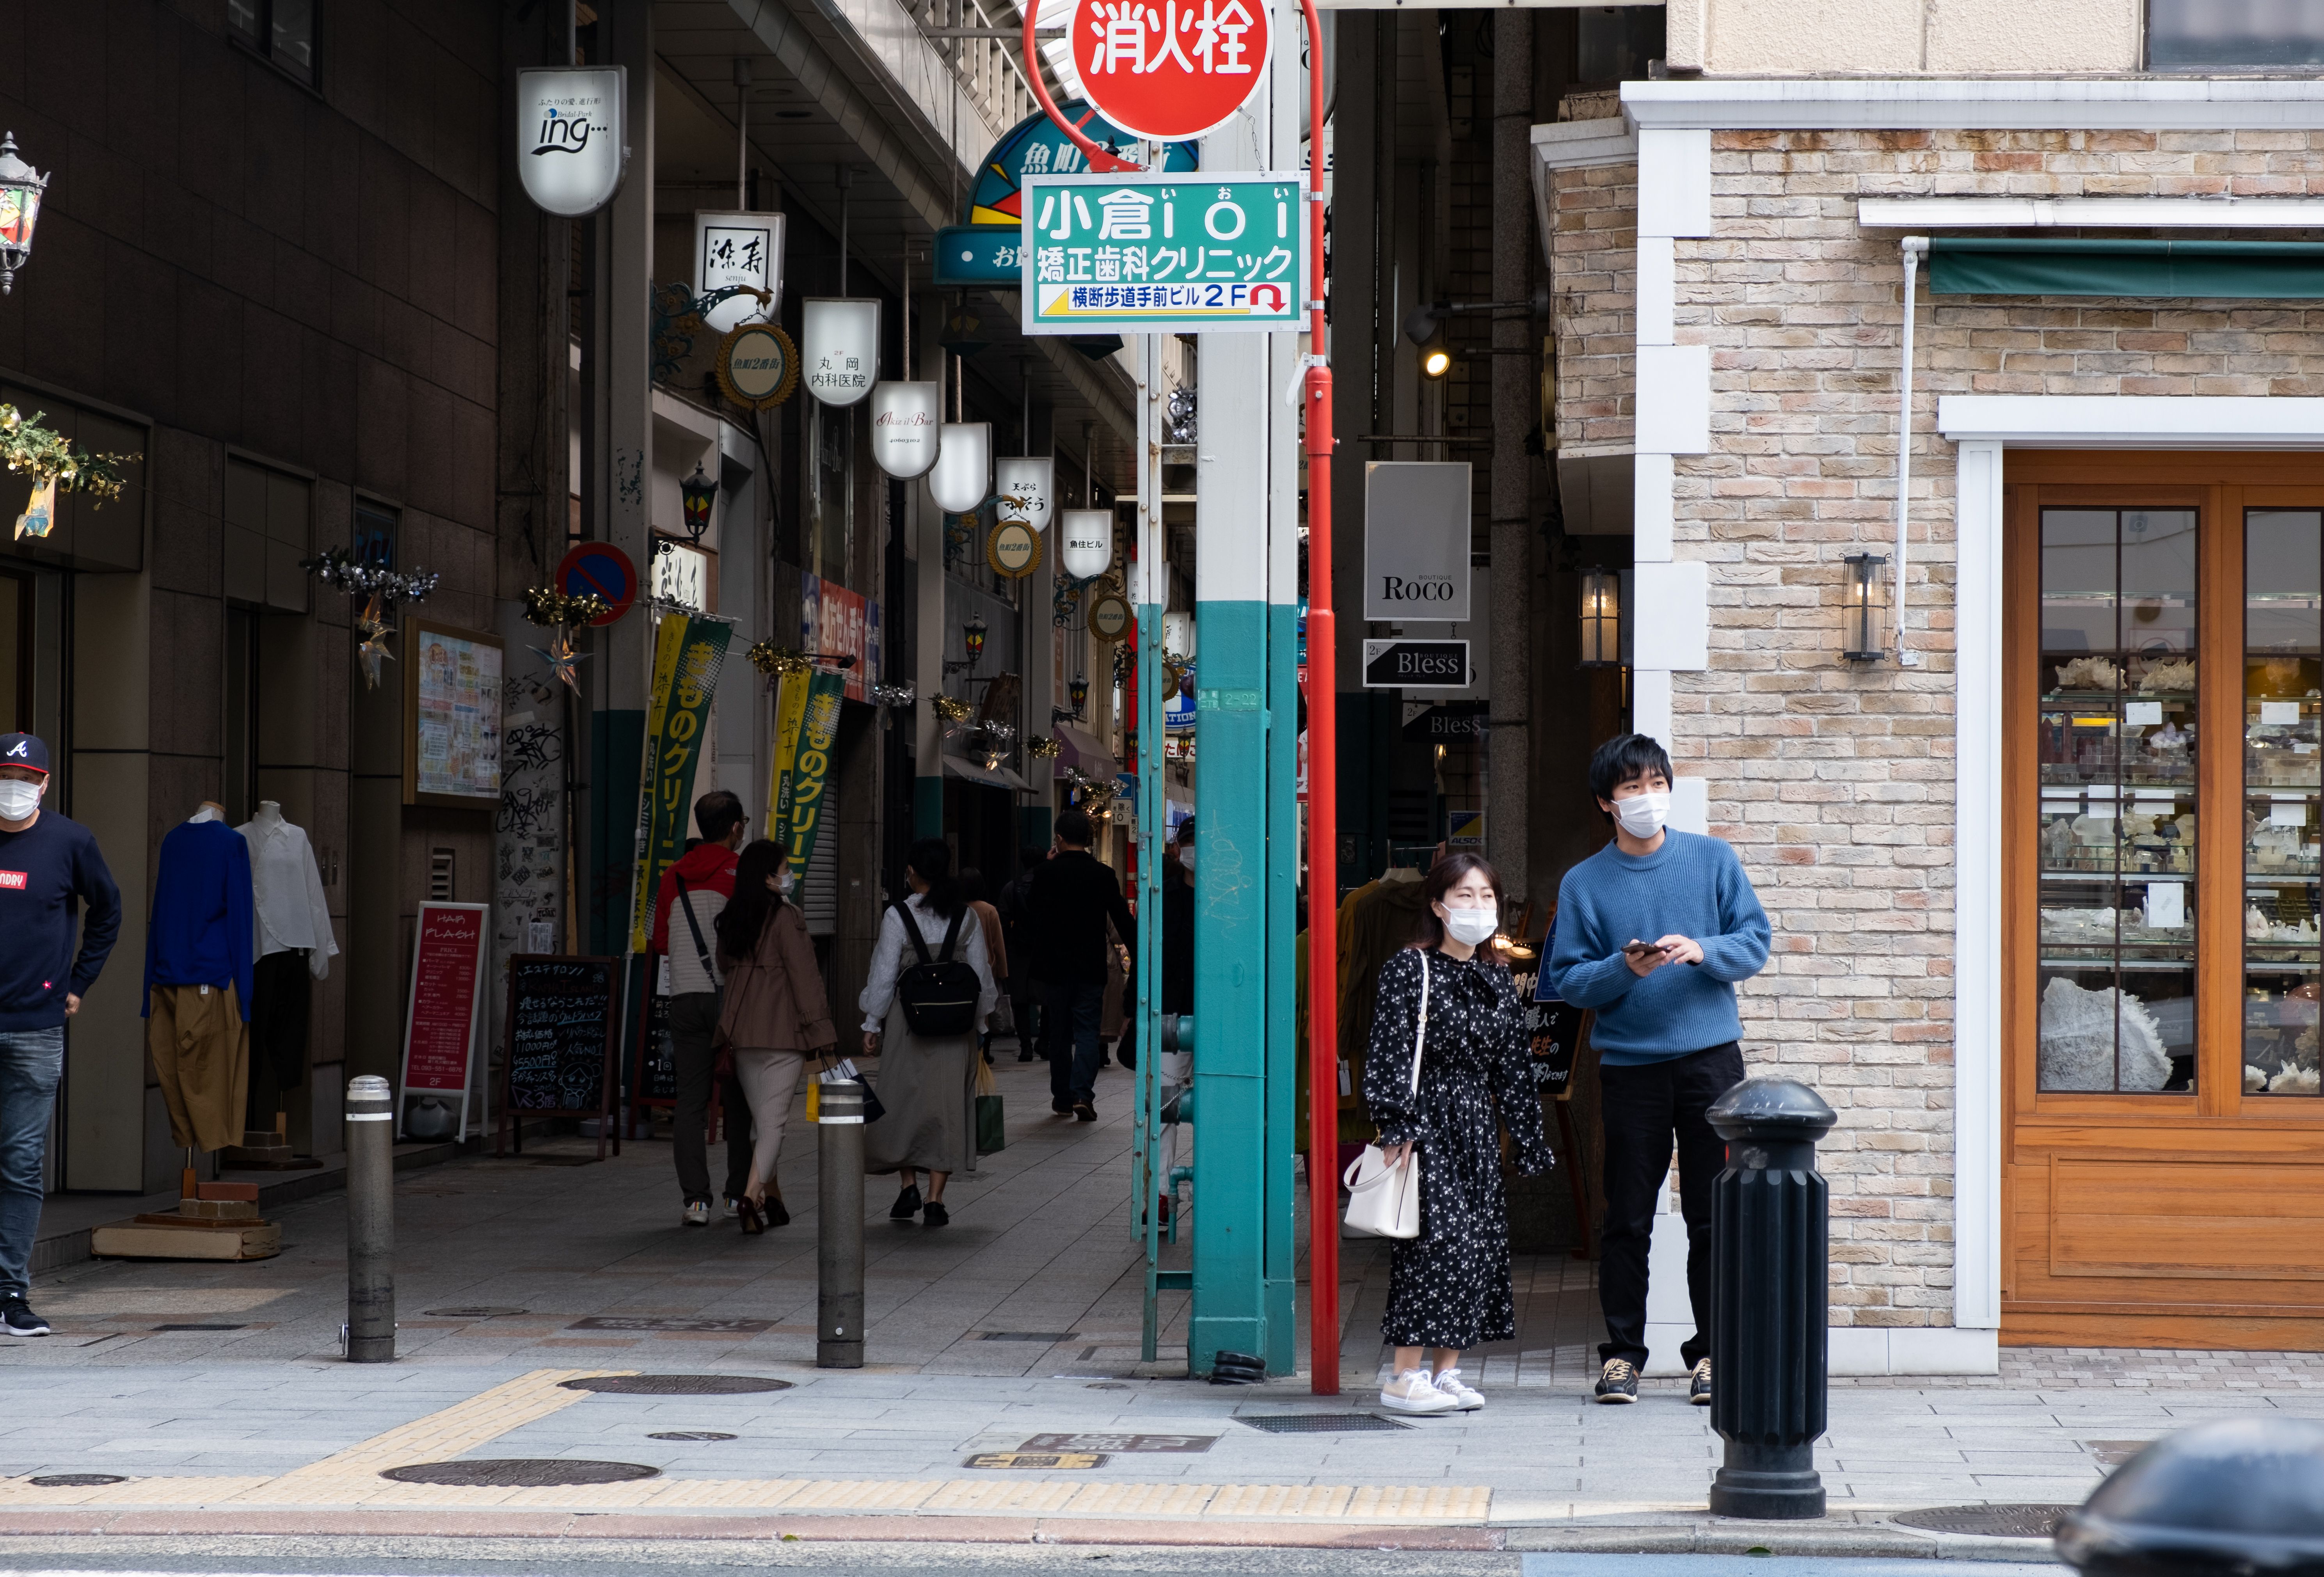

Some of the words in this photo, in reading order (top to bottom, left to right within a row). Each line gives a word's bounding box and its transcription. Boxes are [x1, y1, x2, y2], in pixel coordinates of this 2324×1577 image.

[1090, 0, 1254, 74] 消火栓
[1038, 245, 1292, 282] 矯正歯科クリニック
[725, 274, 746, 283] senju
[1073, 287, 1199, 307] 横断歩道手前ビル
[732, 357, 781, 370] 魚町2番街
[812, 373, 865, 387] 内科医院
[1012, 483, 1036, 491] 天ぷら
[999, 543, 1031, 551] 魚町2番街
[1070, 540, 1103, 549] 魚住ビル
[1369, 645, 1381, 655] 2F
[1397, 652, 1459, 673] Bless
[1225, 694, 1256, 705] 2-22
[1407, 708, 1417, 716] 2F
[1430, 716, 1481, 733] Bless
[659, 642, 714, 877] きものクリーニ
[780, 774, 791, 810] 丸洗い
[437, 914, 465, 924] HAIR
[425, 928, 475, 939] FLASH
[1531, 1035, 1559, 1056] 先生の
[429, 1077, 441, 1086] 2F
[534, 1091, 556, 1109] 3階
